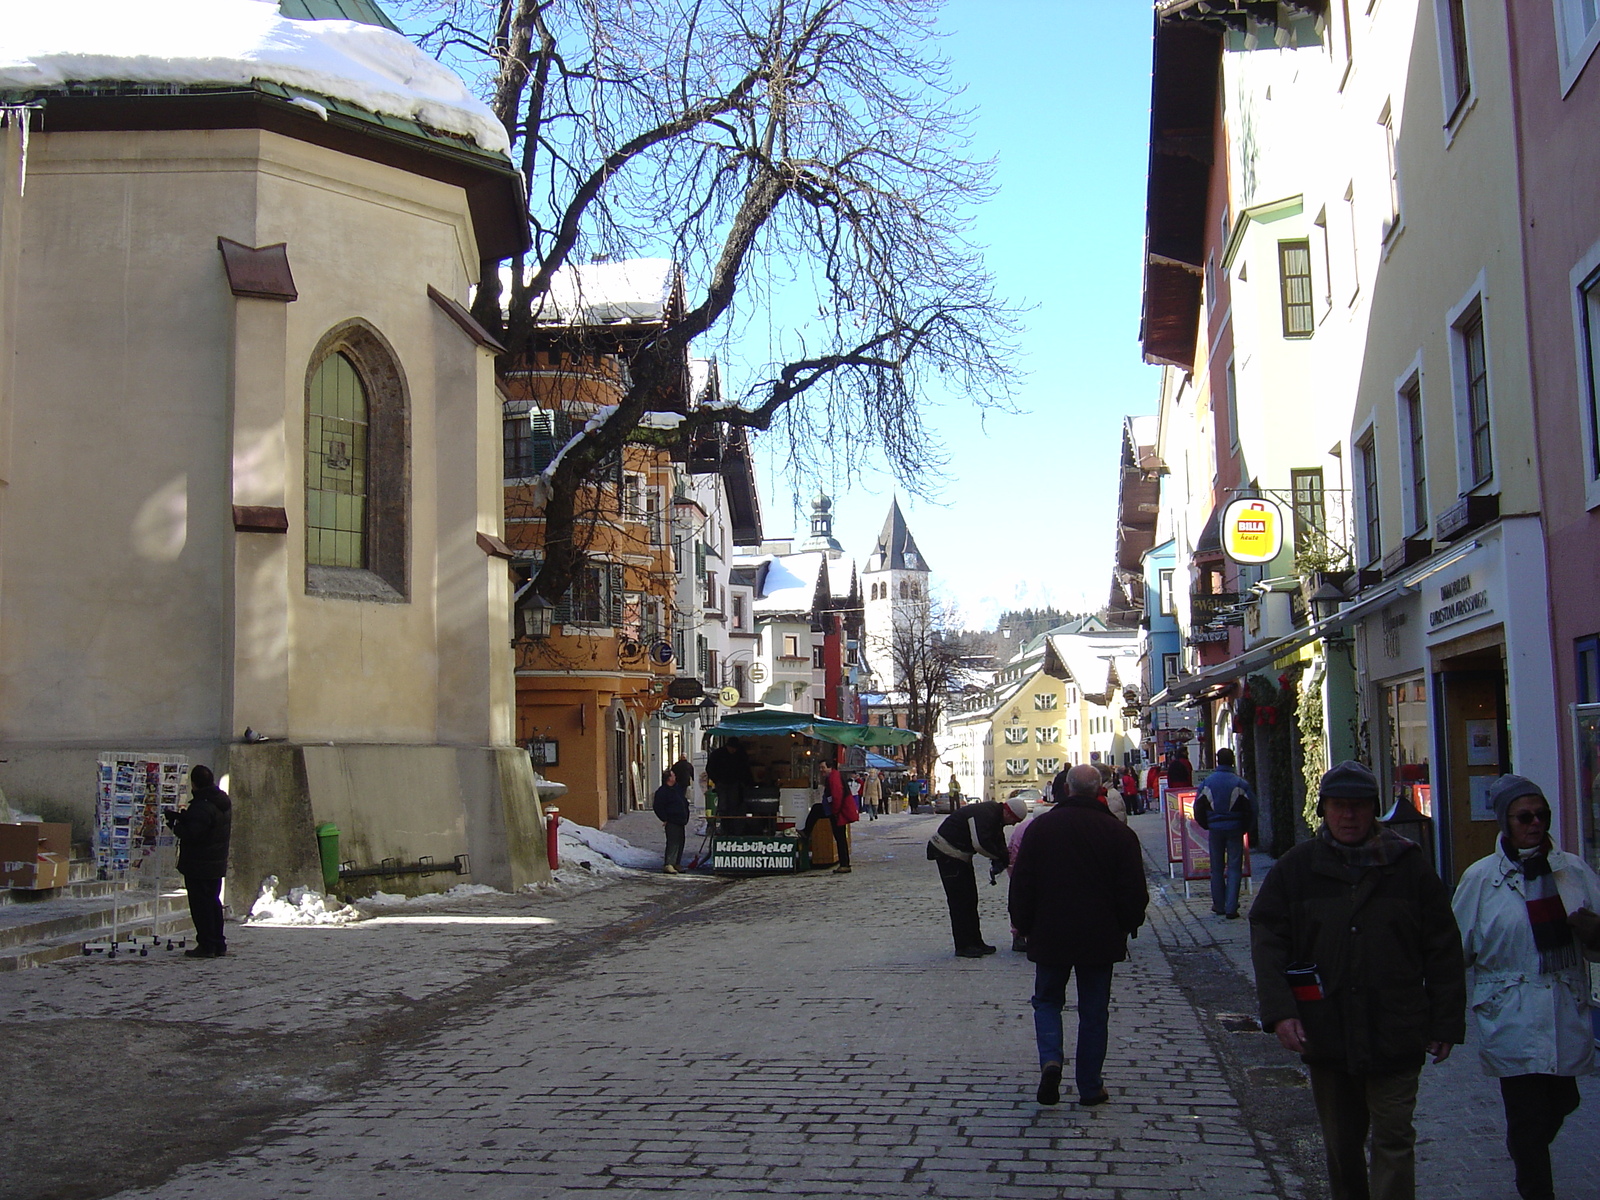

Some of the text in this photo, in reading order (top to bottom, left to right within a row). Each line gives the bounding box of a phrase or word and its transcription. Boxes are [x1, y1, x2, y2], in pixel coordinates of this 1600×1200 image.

[1238, 521, 1265, 532] BILLA
[1240, 533, 1259, 541] heute
[716, 841, 794, 854] Kitzbüheler
[714, 856, 794, 868] MARONISTANDL
